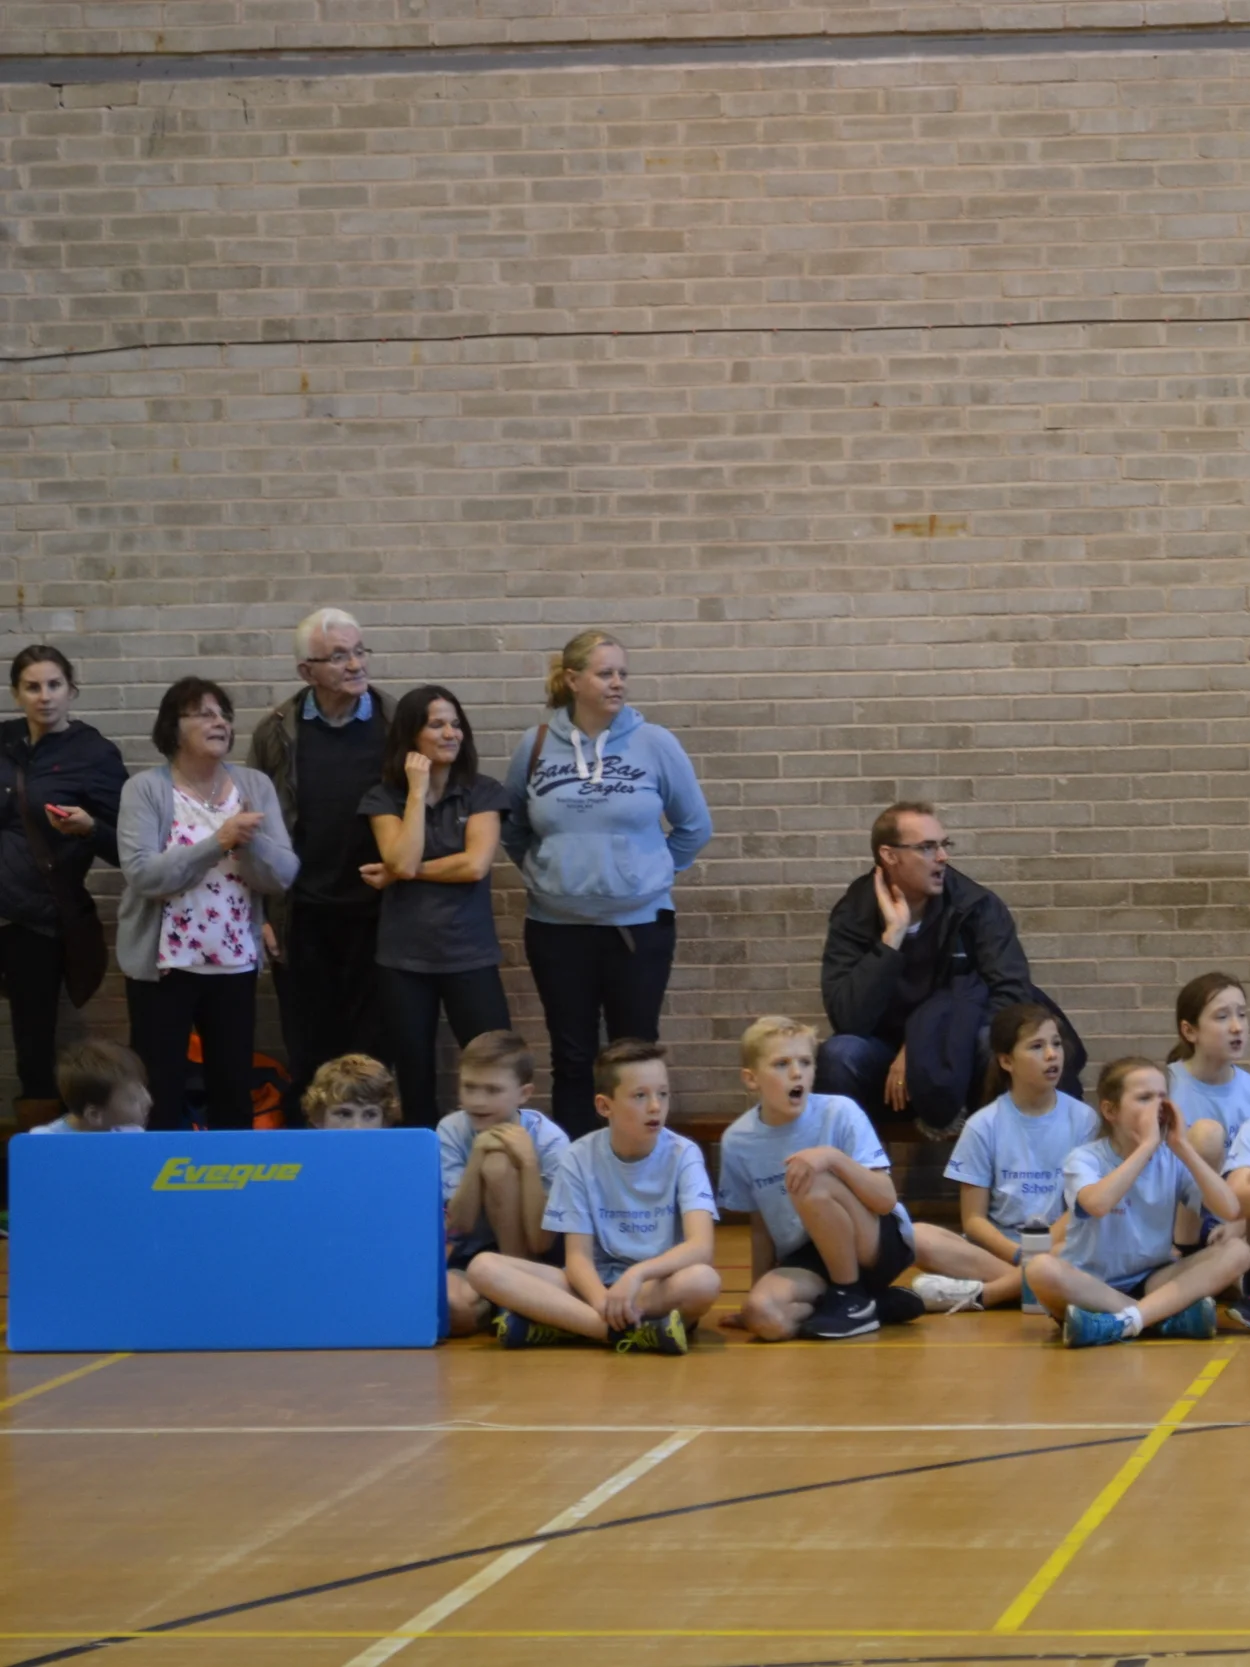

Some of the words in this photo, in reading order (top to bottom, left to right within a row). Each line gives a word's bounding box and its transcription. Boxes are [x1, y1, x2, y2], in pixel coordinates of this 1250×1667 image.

[600, 755, 647, 781] Bay
[578, 780, 636, 796] Eagles
[151, 1156, 303, 1191] Eveque
[1021, 1182, 1057, 1194] School
[618, 1221, 658, 1234] School
